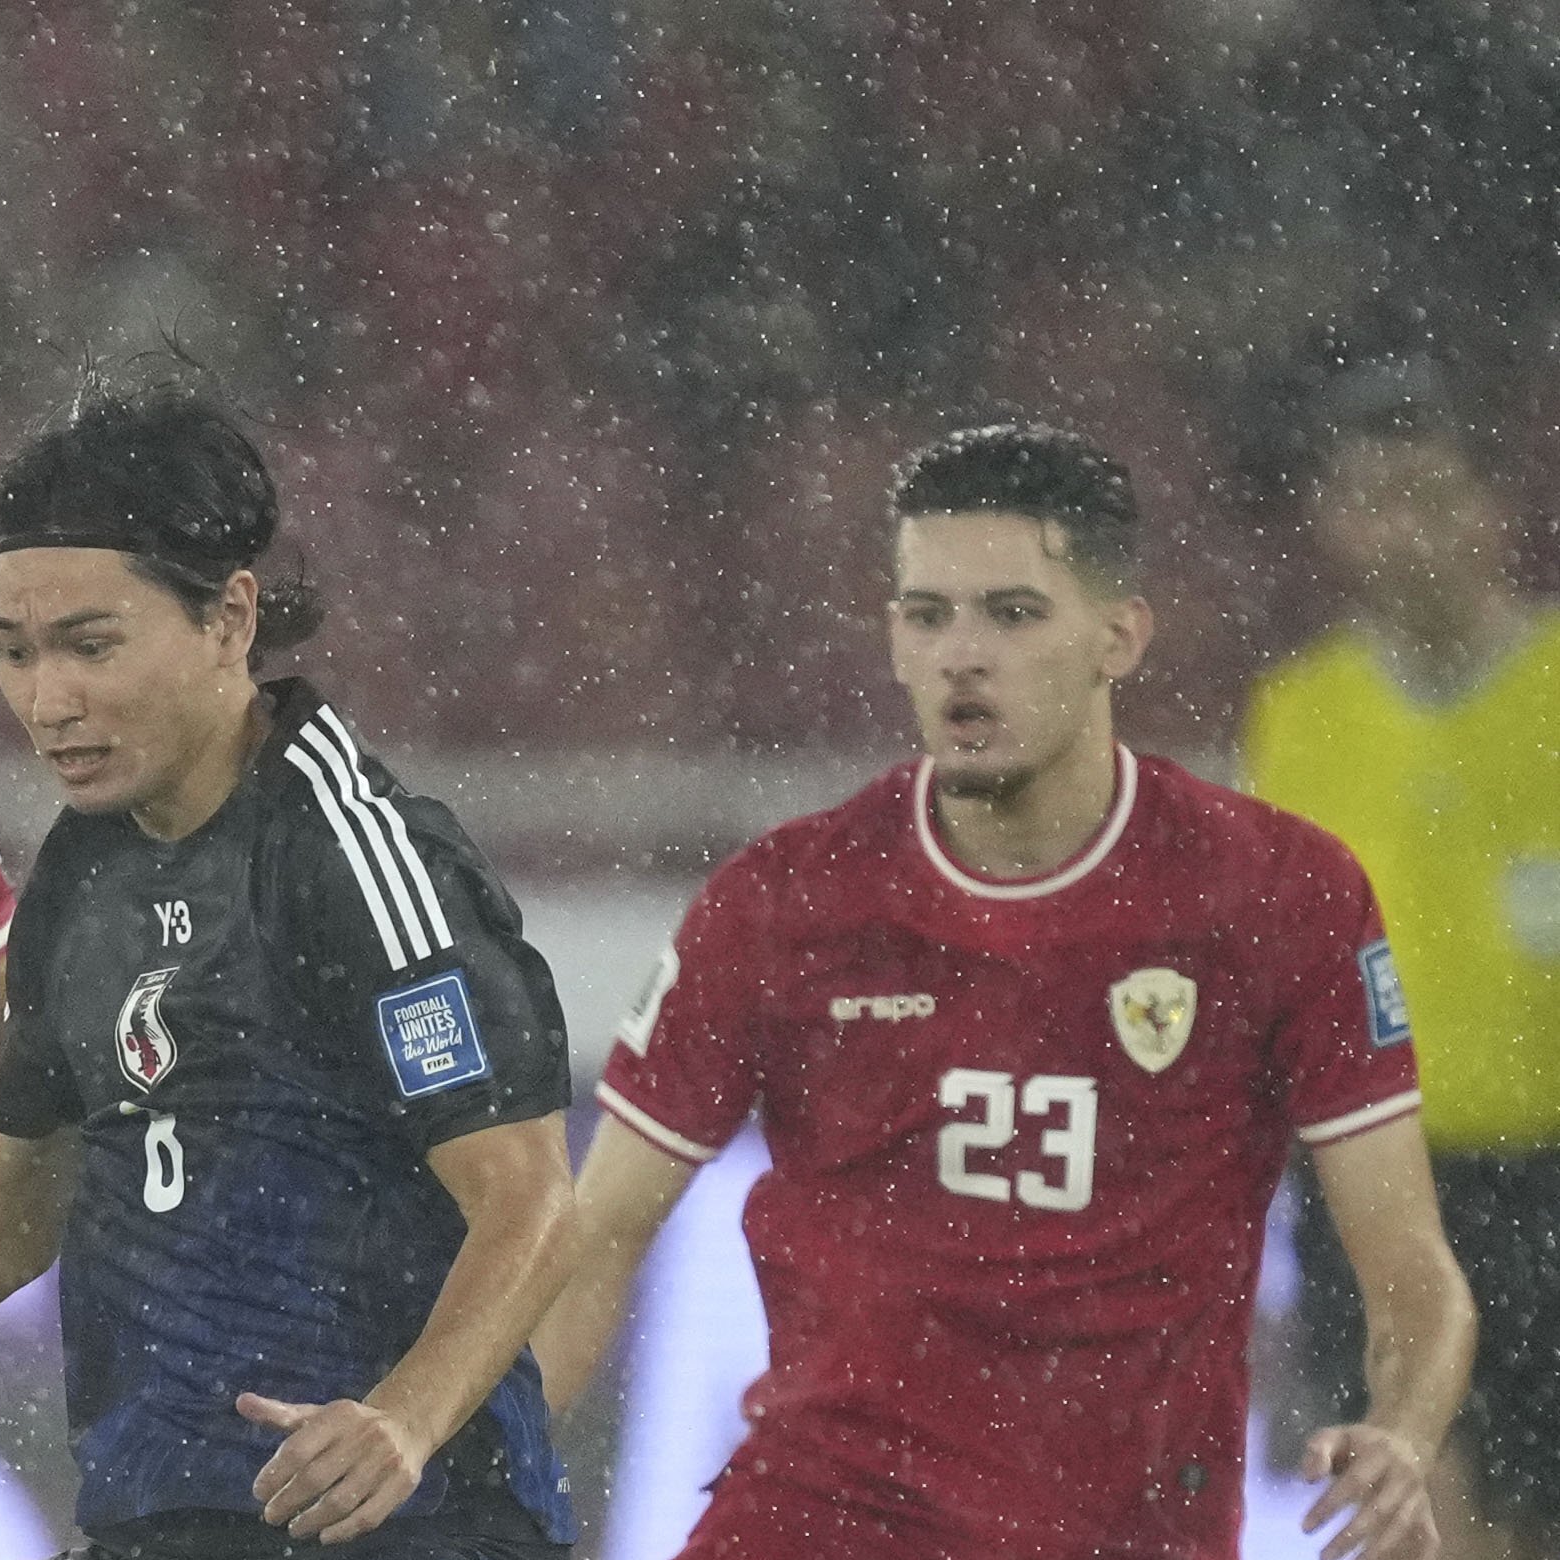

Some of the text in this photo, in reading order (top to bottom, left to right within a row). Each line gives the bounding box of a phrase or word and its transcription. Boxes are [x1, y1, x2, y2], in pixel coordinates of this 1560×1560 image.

[153, 900, 192, 946] Y-3
[394, 994, 450, 1024] FOOTBALL
[399, 1008, 456, 1042] UNITES
[402, 1027, 463, 1061] the World
[427, 1057, 450, 1070] FIFA
[937, 1067, 1098, 1212] 23
